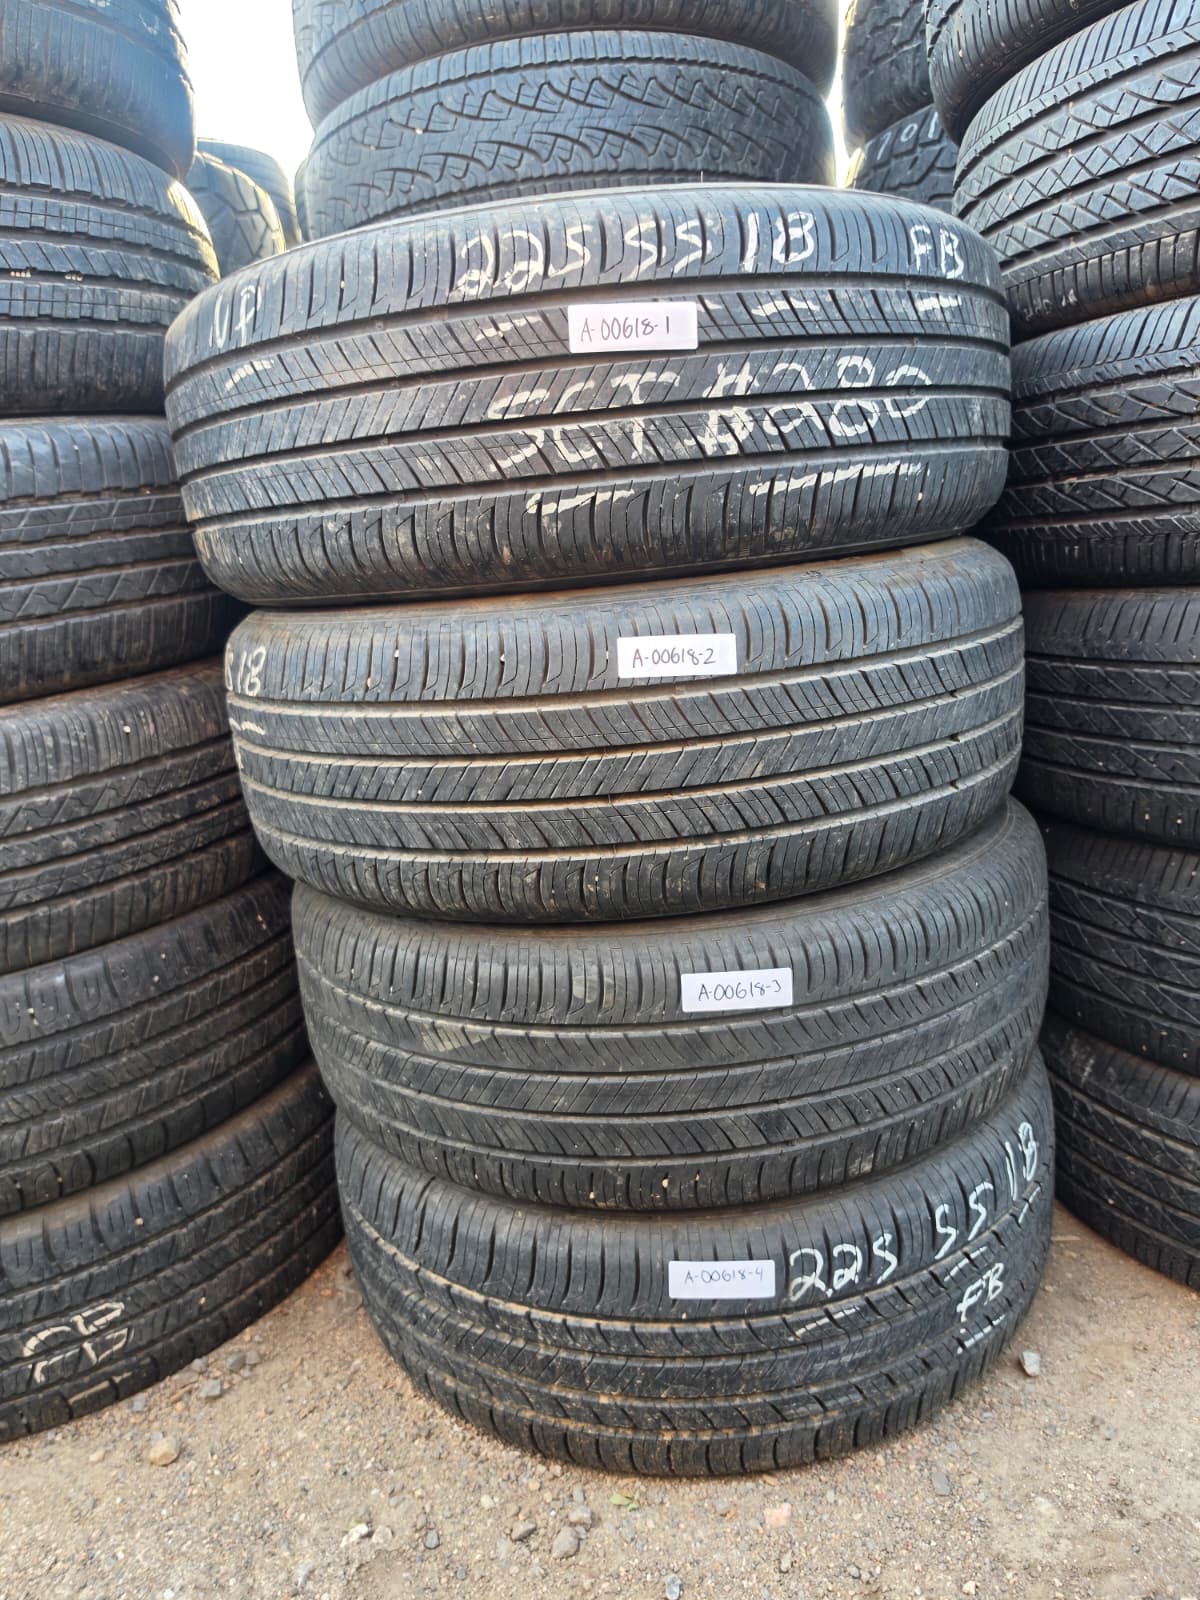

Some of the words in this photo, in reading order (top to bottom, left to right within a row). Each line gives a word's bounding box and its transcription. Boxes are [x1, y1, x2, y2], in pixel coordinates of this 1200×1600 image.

[446, 223, 593, 294] 225
[741, 211, 815, 273] 18
[580, 315, 670, 343] A-00618-1
[632, 647, 717, 669] A-00618-2
[698, 979, 782, 1002] A-00618-3
[684, 1267, 764, 1285] A-00618-4
[787, 1232, 899, 1302] 225
[956, 1262, 1005, 1323] FB
